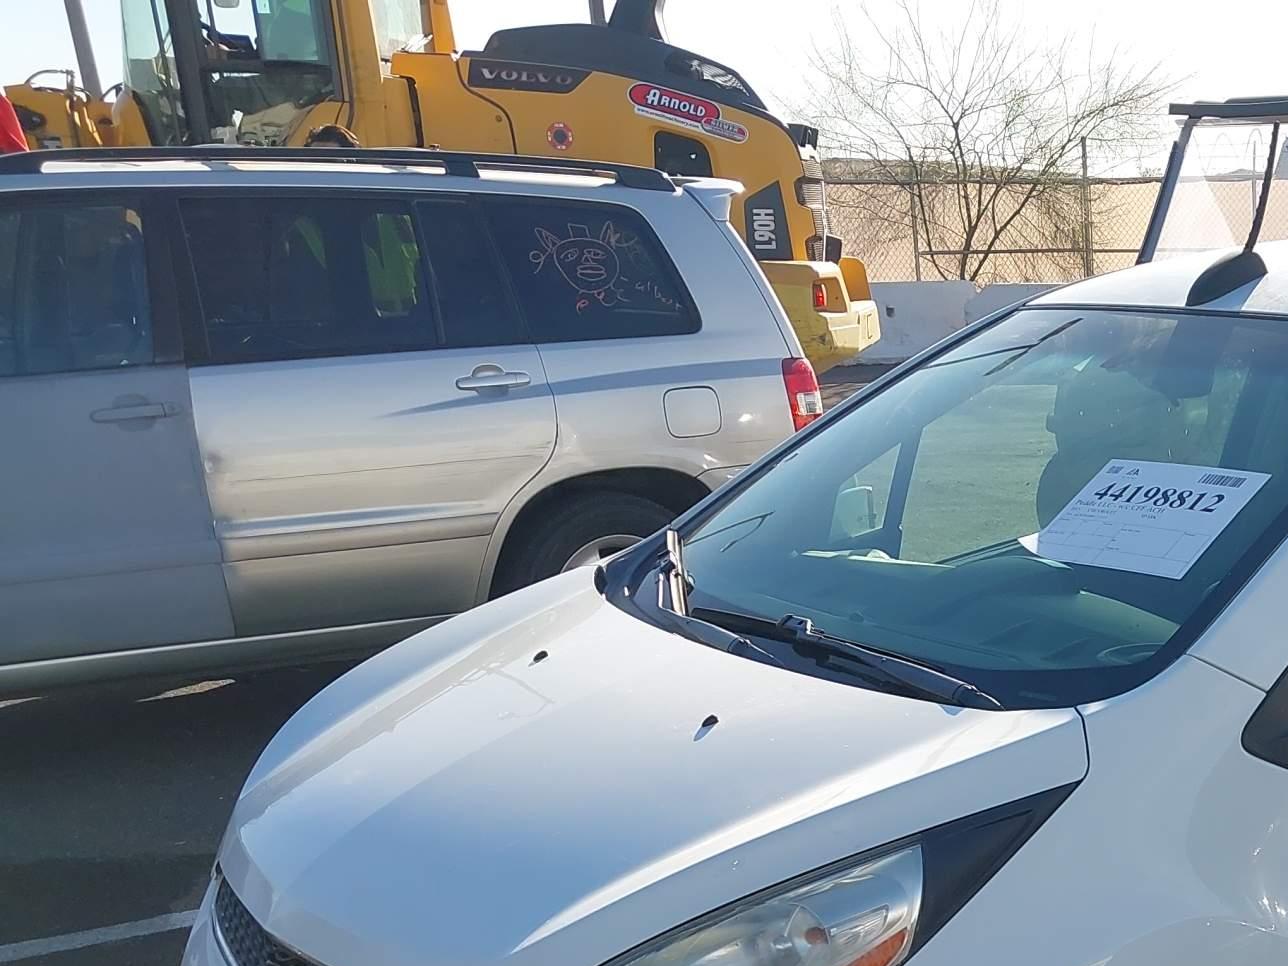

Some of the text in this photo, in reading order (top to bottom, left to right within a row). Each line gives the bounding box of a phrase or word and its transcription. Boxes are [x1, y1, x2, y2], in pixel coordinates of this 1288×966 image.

[481, 67, 572, 85] VOLVO
[646, 87, 706, 117] ARNOLD
[752, 208, 777, 250] L90H
[1094, 482, 1226, 513] 44198812
